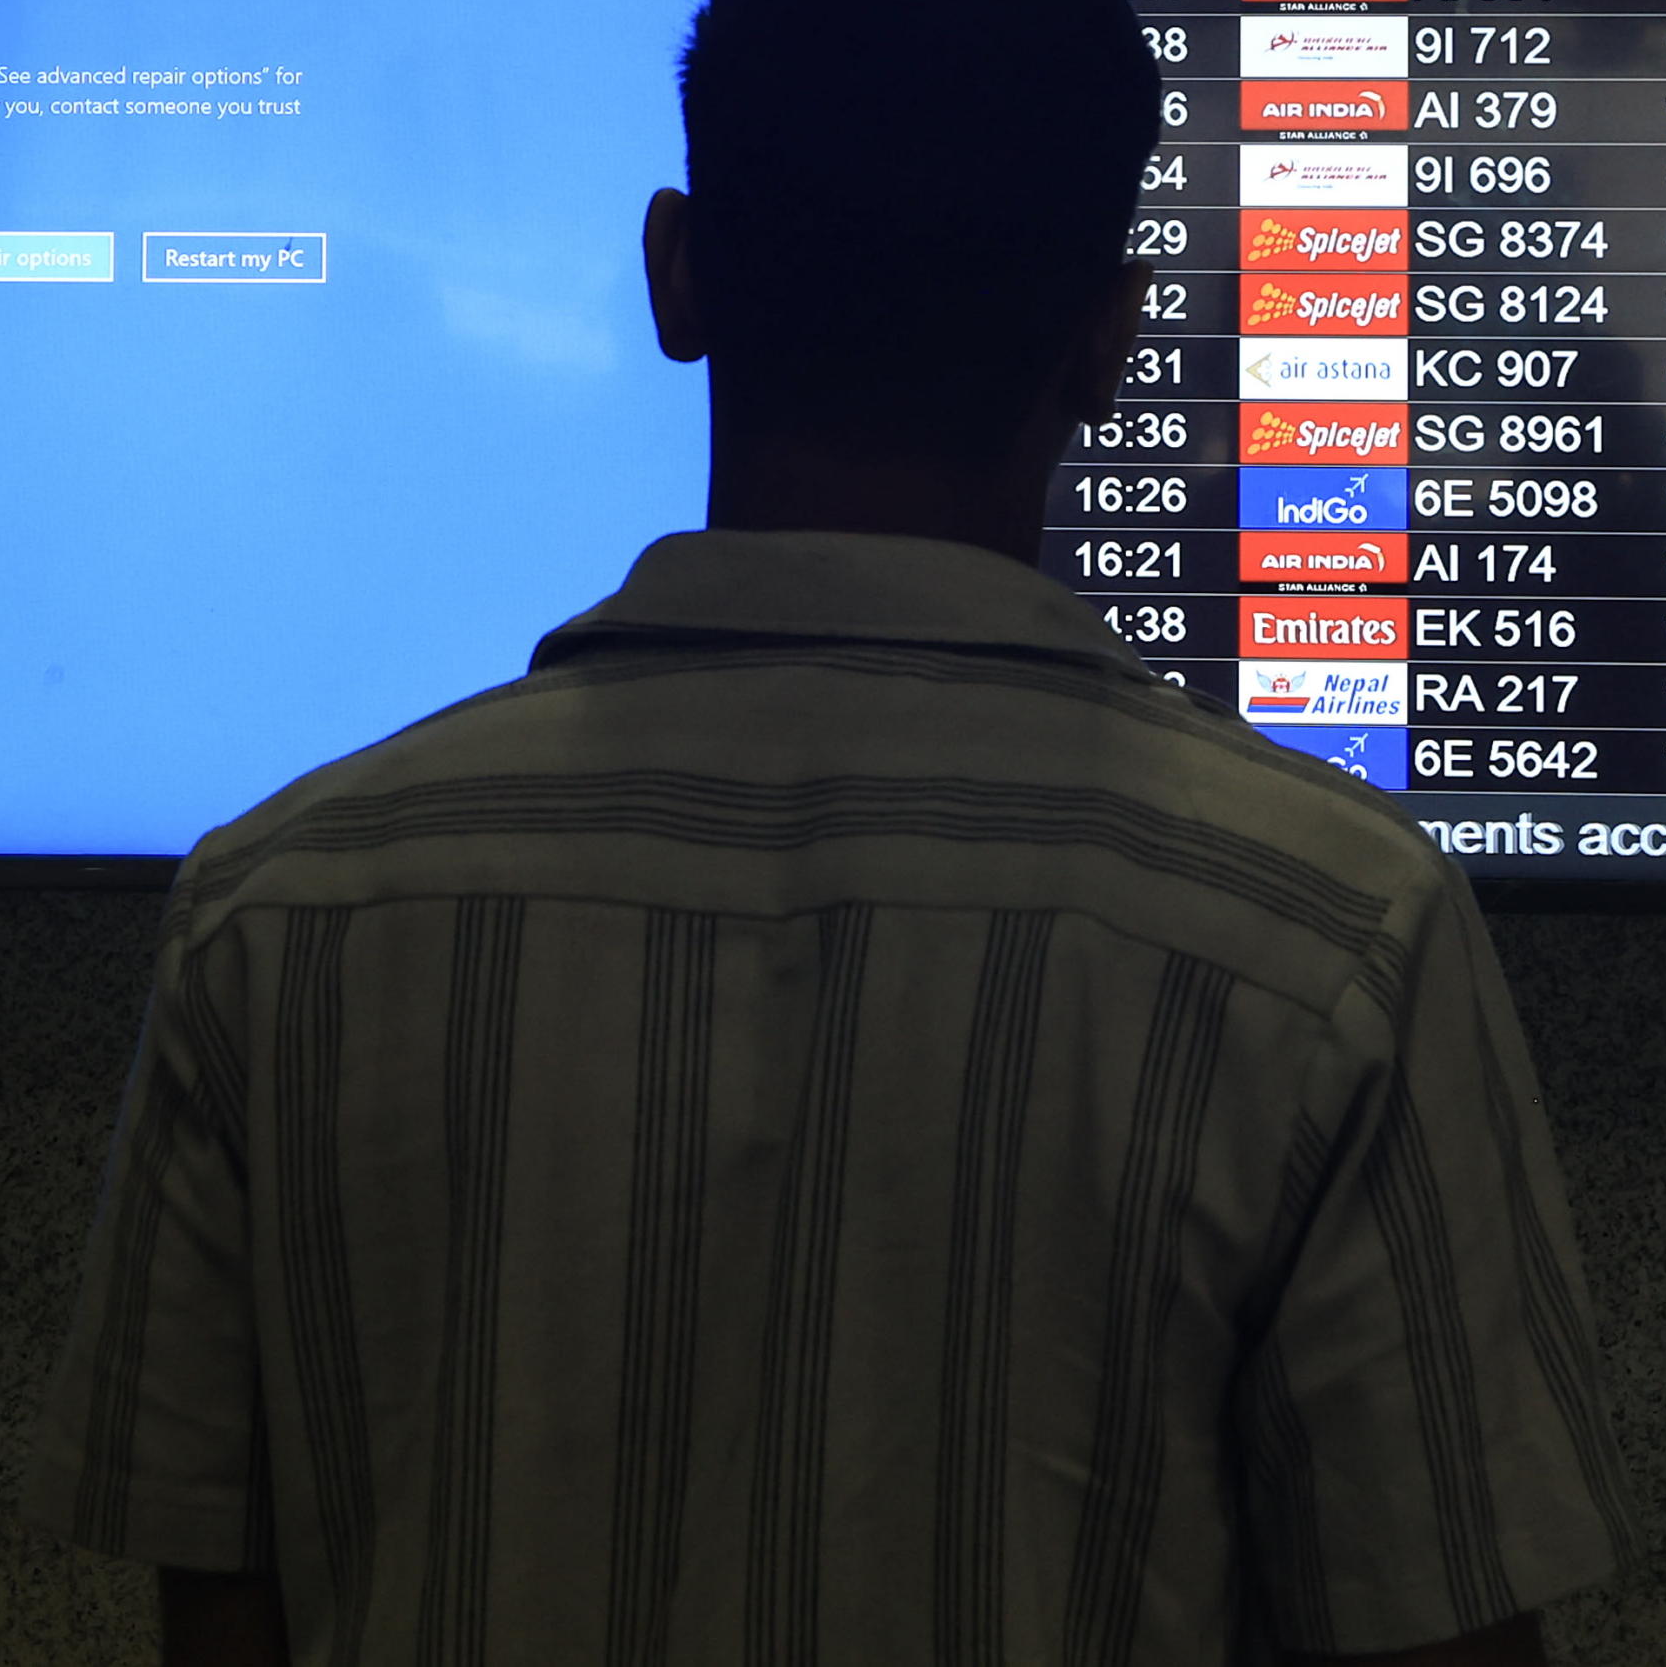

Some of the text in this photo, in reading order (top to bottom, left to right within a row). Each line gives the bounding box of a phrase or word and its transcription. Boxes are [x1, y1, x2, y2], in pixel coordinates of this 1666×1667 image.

[1415, 27, 1551, 64] 9I 712
[1261, 102, 1373, 117] AIR INDIA
[1413, 91, 1557, 129] AI 379
[1415, 155, 1551, 194] 9I 696
[1126, 219, 1188, 255] :29
[1414, 220, 1609, 259] SG 8374
[165, 248, 304, 272] Restart my PC
[1414, 285, 1609, 323] SG 8124
[1125, 347, 1181, 384] :31
[1280, 356, 1391, 380] air astana
[1416, 349, 1579, 388] KC 907
[1083, 412, 1187, 448] 15:36
[1414, 414, 1602, 453] SG 8961
[1075, 476, 1187, 513] 16:26
[1414, 479, 1598, 518] 6E 5098
[1075, 541, 1181, 578] 16:21
[1261, 553, 1373, 568] AIR INDIA
[1413, 544, 1557, 583] AI 174
[1252, 611, 1397, 645] Emirates
[1416, 608, 1576, 648] EK 516
[1311, 694, 1400, 715] Airlines
[1323, 673, 1390, 700] Nepal
[1416, 673, 1579, 713] RA 217
[1414, 739, 1474, 777] 6E
[1488, 740, 1598, 779] 5642
